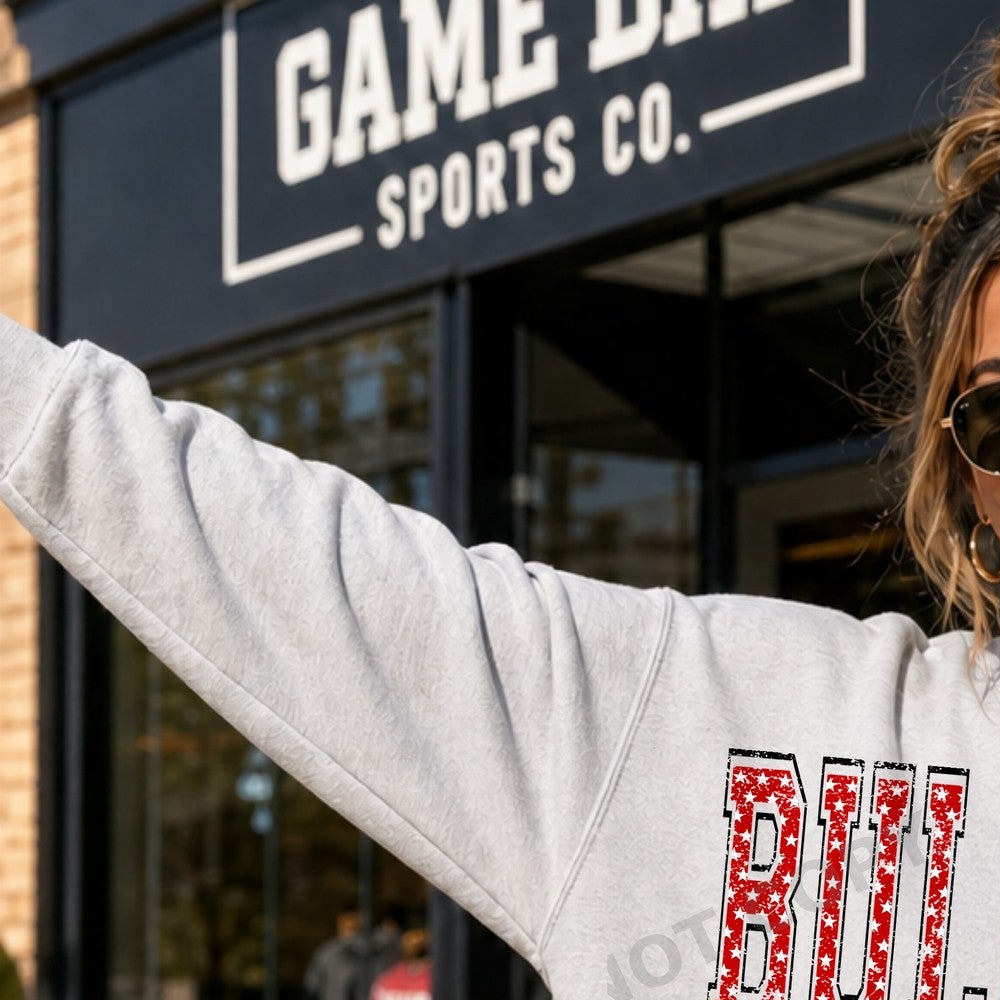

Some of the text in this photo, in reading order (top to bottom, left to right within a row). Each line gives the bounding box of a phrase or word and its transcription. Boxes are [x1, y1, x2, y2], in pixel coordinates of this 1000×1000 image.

[276, 0, 558, 186] GAME
[376, 82, 691, 250] SPORTS CO.
